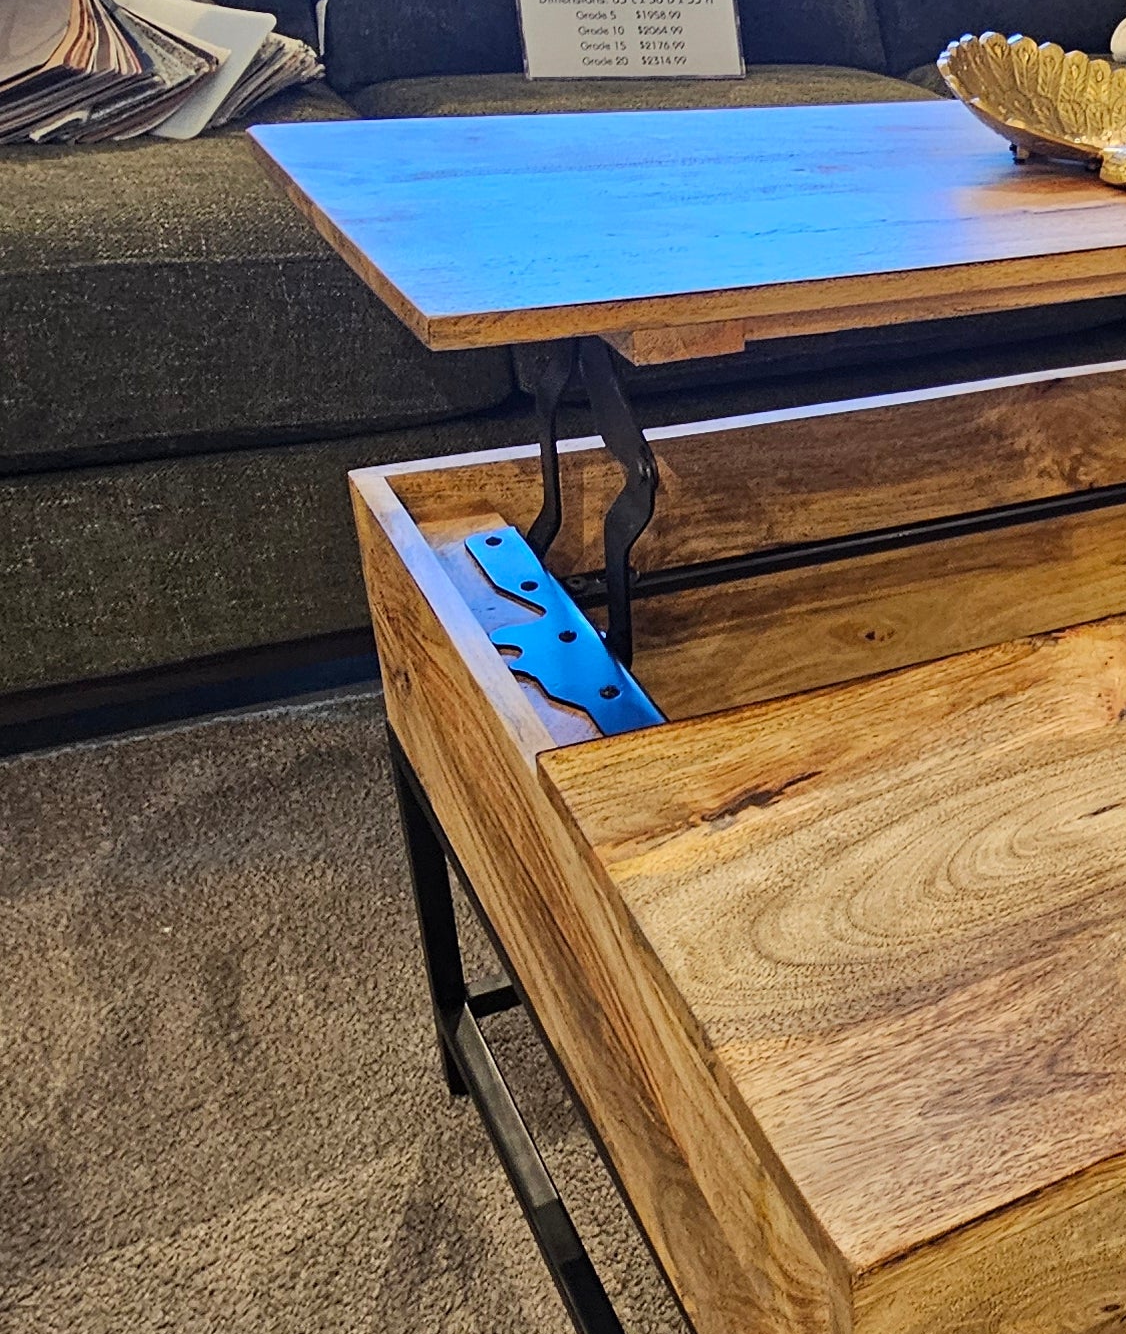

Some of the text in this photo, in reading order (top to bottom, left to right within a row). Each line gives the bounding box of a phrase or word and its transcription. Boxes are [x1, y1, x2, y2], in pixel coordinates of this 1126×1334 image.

[576, 10, 607, 20] Grade
[609, 10, 617, 20] 5
[578, 25, 609, 36] Grade
[612, 25, 625, 36] 10
[580, 41, 611, 51] Grade
[615, 41, 627, 51] 15
[582, 56, 613, 66] Grade
[616, 56, 629, 66] 20
